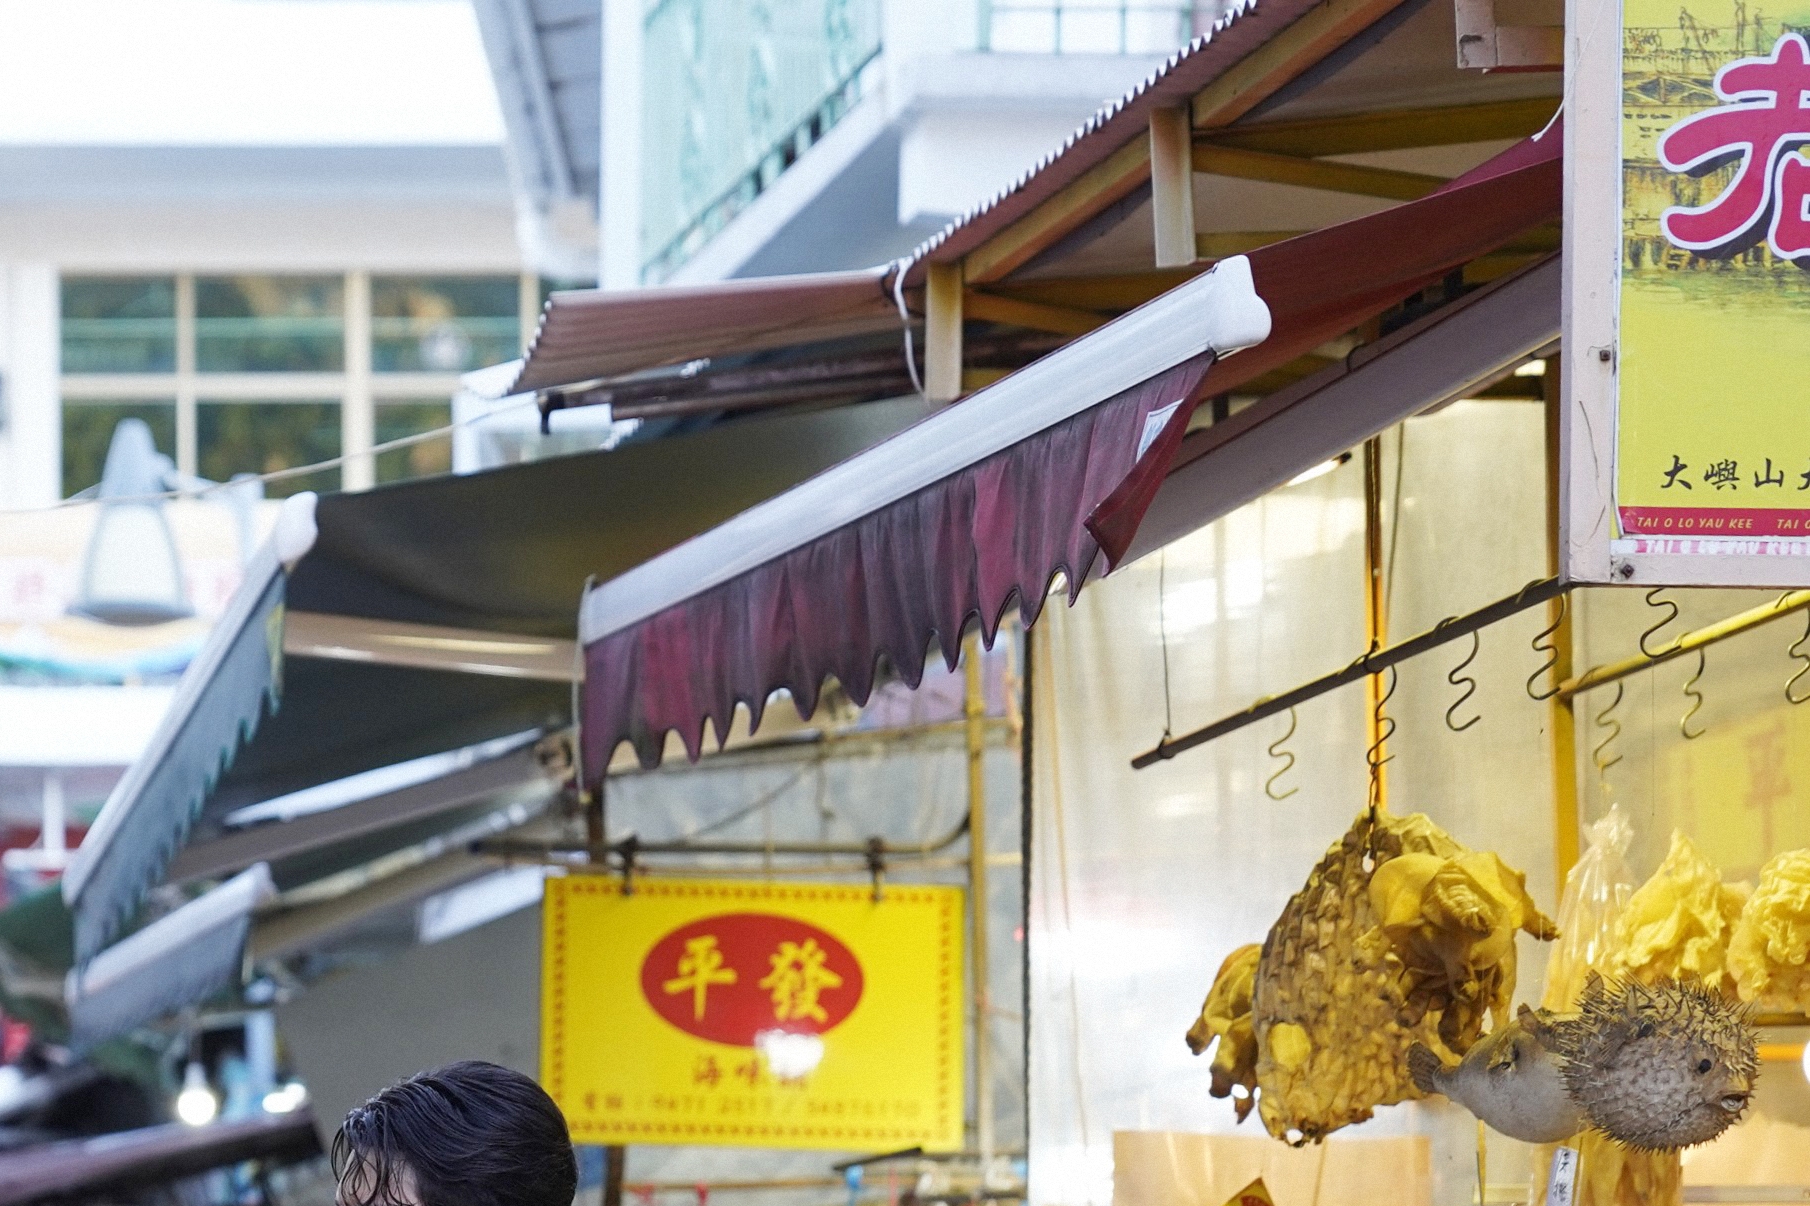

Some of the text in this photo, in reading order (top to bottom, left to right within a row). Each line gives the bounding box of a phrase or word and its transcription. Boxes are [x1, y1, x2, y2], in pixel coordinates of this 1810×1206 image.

[1637, 517, 1659, 528] TAI
[1664, 517, 1674, 528] O
[1678, 518, 1694, 529] LO
[1699, 518, 1724, 529] YAU
[1729, 518, 1754, 529] KEE
[1776, 519, 1799, 530] TAI
[662, 934, 844, 1023] 平發
